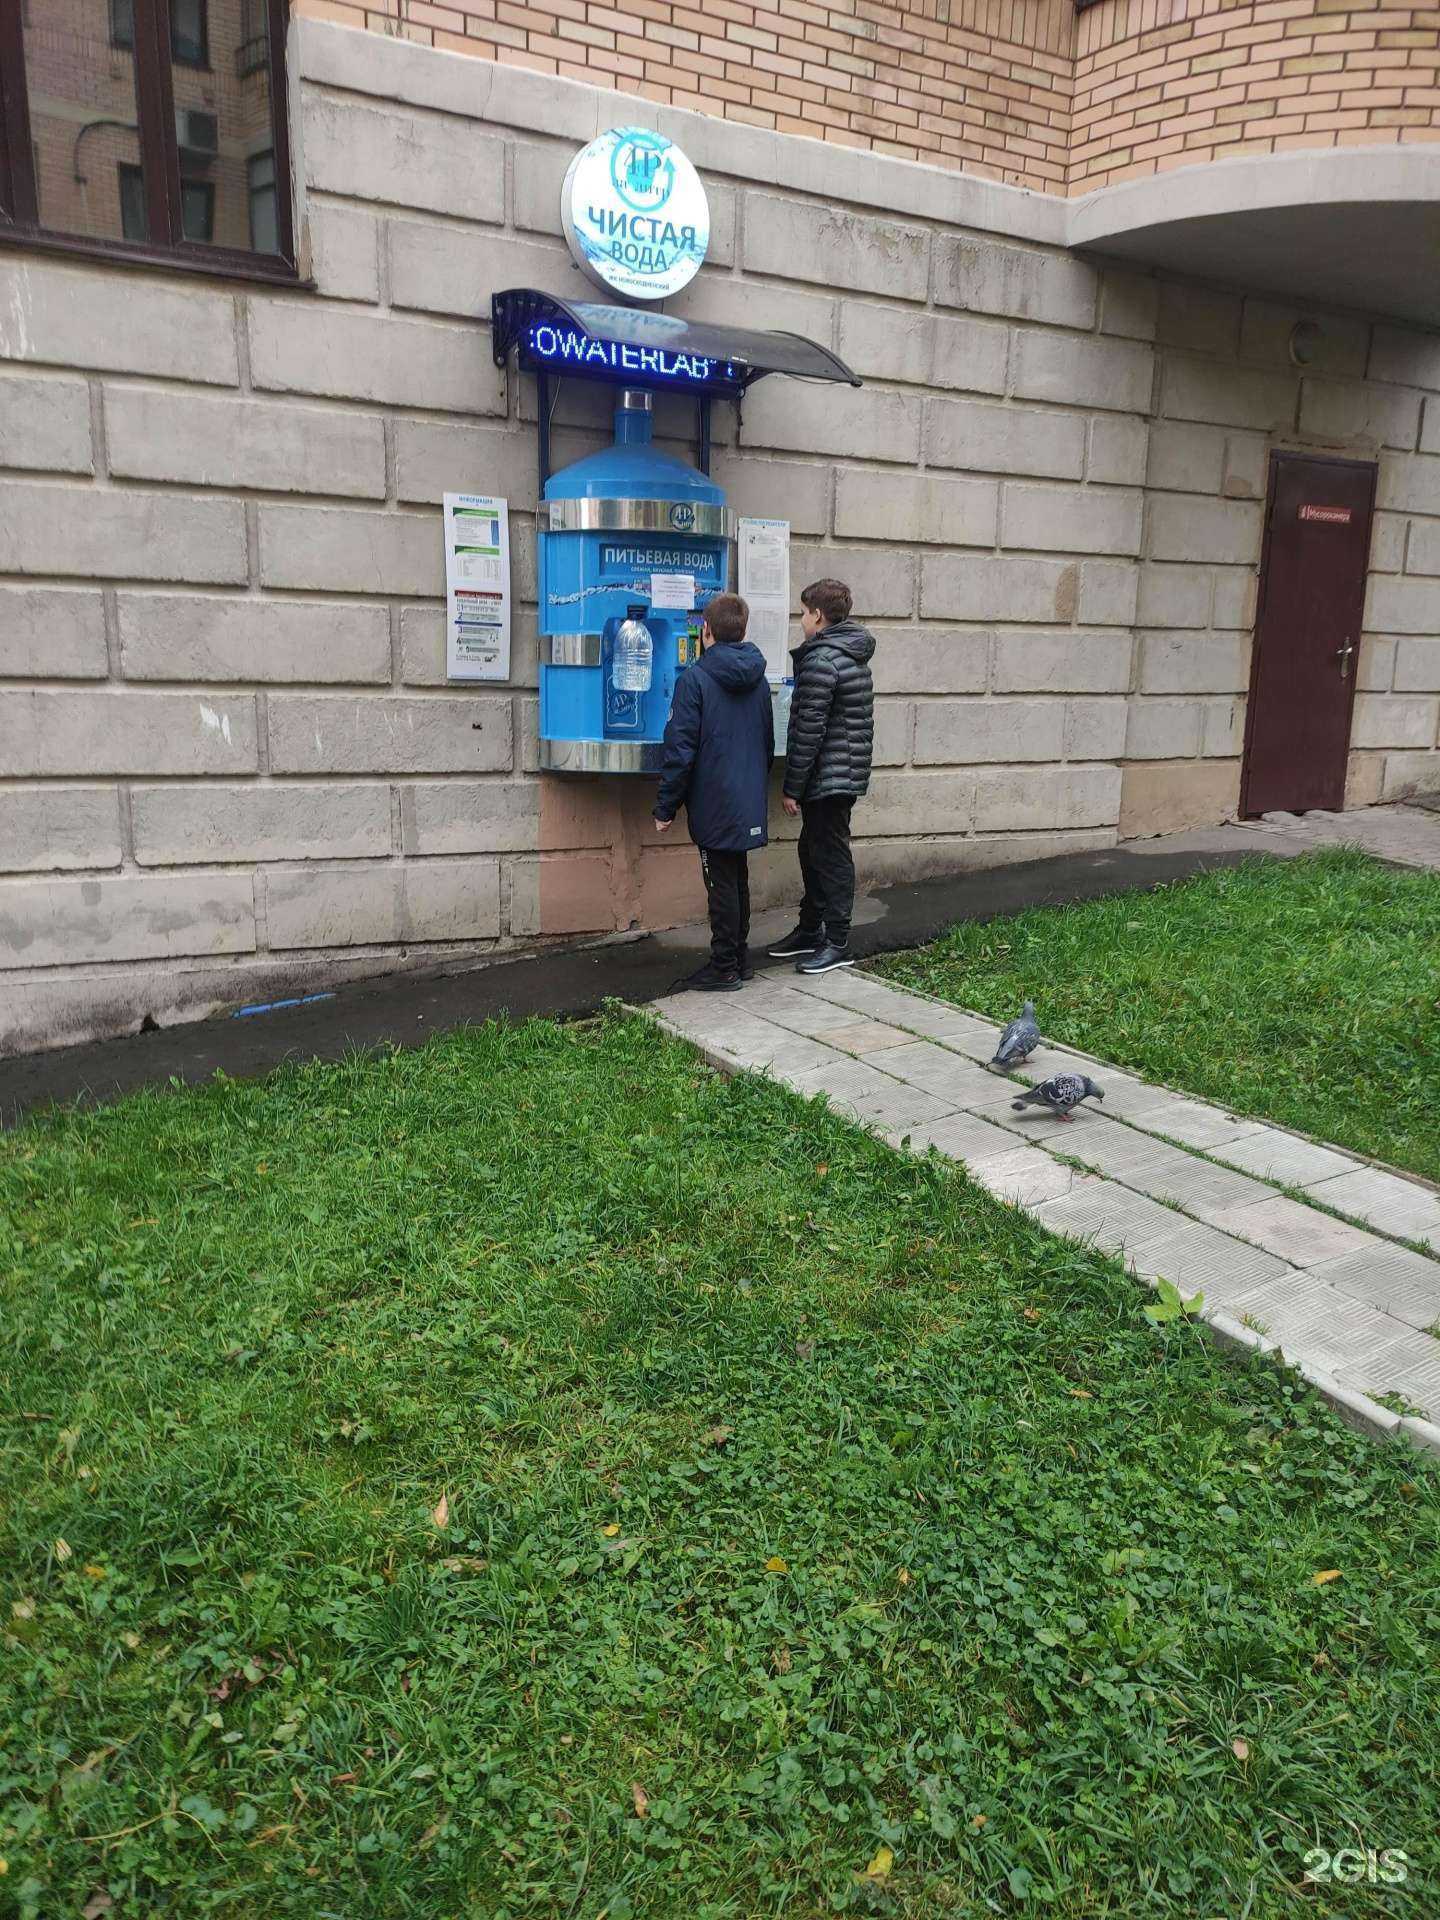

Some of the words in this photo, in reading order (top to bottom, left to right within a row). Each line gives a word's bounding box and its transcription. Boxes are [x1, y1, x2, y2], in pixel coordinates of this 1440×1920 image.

[588, 206, 696, 251] ЧИСТАЯ
[611, 241, 669, 271] ВОДА
[604, 548, 680, 566] ПИТЬЕВАЯ
[684, 553, 714, 571] ВОДА
